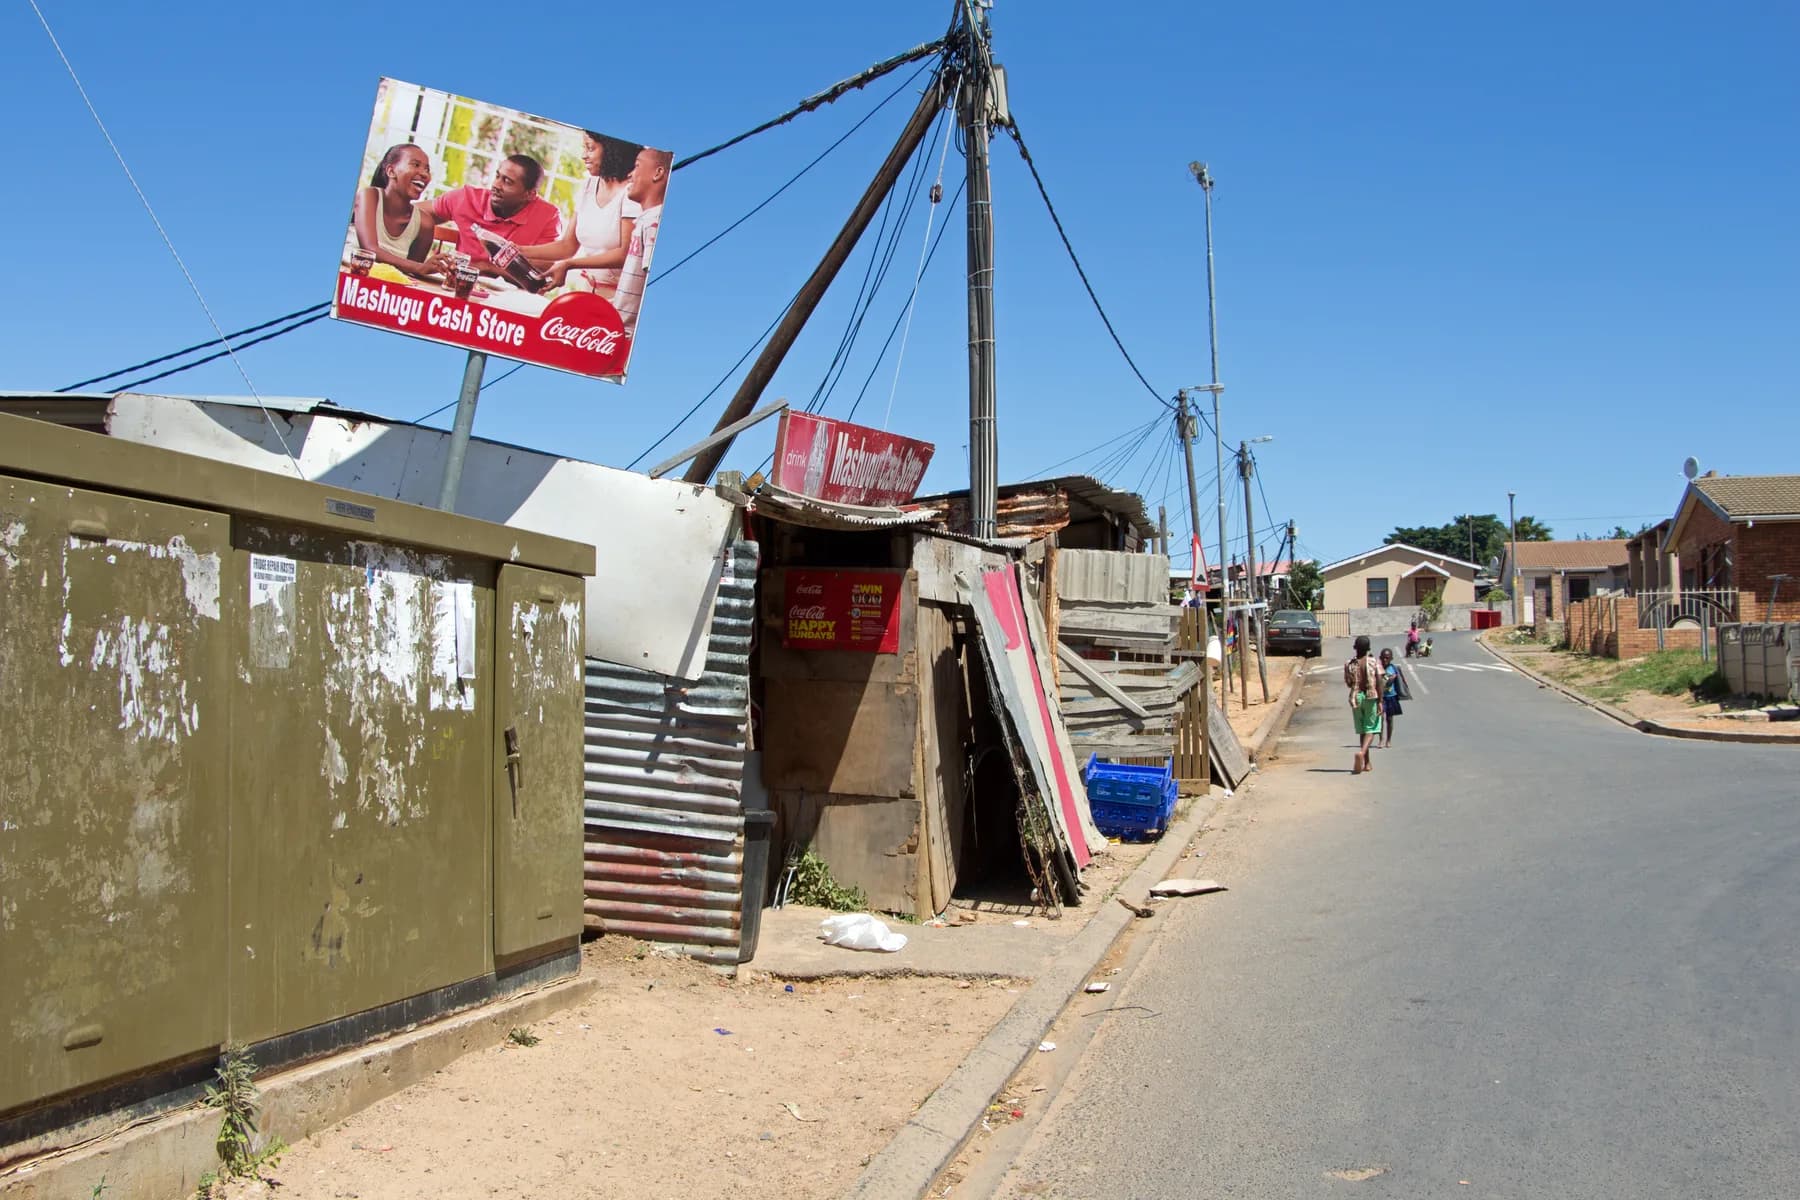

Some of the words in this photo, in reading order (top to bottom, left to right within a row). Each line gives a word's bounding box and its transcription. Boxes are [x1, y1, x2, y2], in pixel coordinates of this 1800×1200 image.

[341, 276, 423, 325] Mashugu
[427, 298, 473, 332] Cash
[476, 311, 526, 346] Store
[540, 317, 622, 356] Coca-Cola
[786, 451, 807, 469] drink
[829, 431, 883, 501] Mashugu
[253, 558, 266, 571] FRIDGE
[267, 559, 279, 572] REPAIR
[860, 584, 882, 594] WIN
[789, 620, 836, 632] HAPPY
